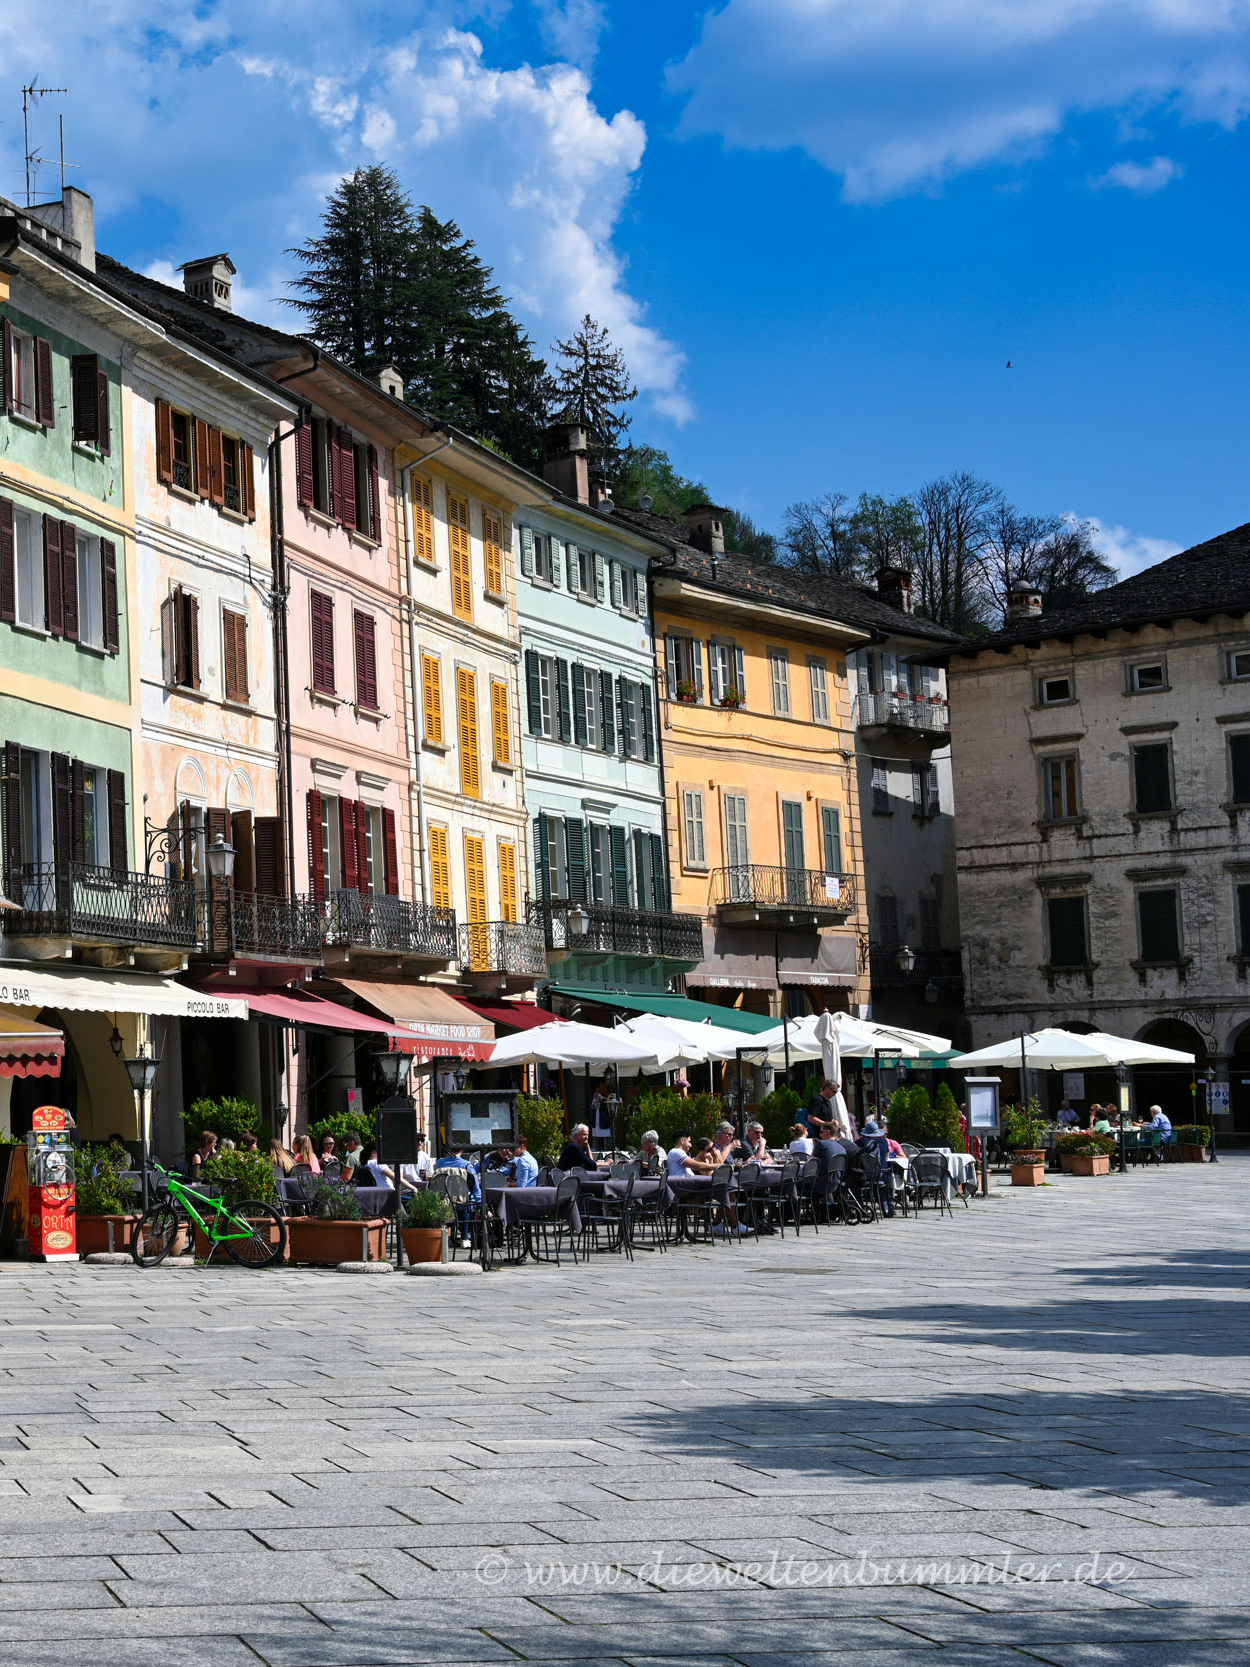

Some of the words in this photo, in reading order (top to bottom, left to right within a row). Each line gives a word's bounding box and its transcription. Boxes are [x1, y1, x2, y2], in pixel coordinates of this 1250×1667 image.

[13, 987, 31, 1002] BAR
[187, 1001, 214, 1014] PICCOLO
[216, 1003, 230, 1015] BAR
[450, 1025, 466, 1039] FOOD
[467, 1026, 482, 1039] SHOP
[413, 1043, 453, 1057] ristorante
[42, 1215, 73, 1230] ORTA
